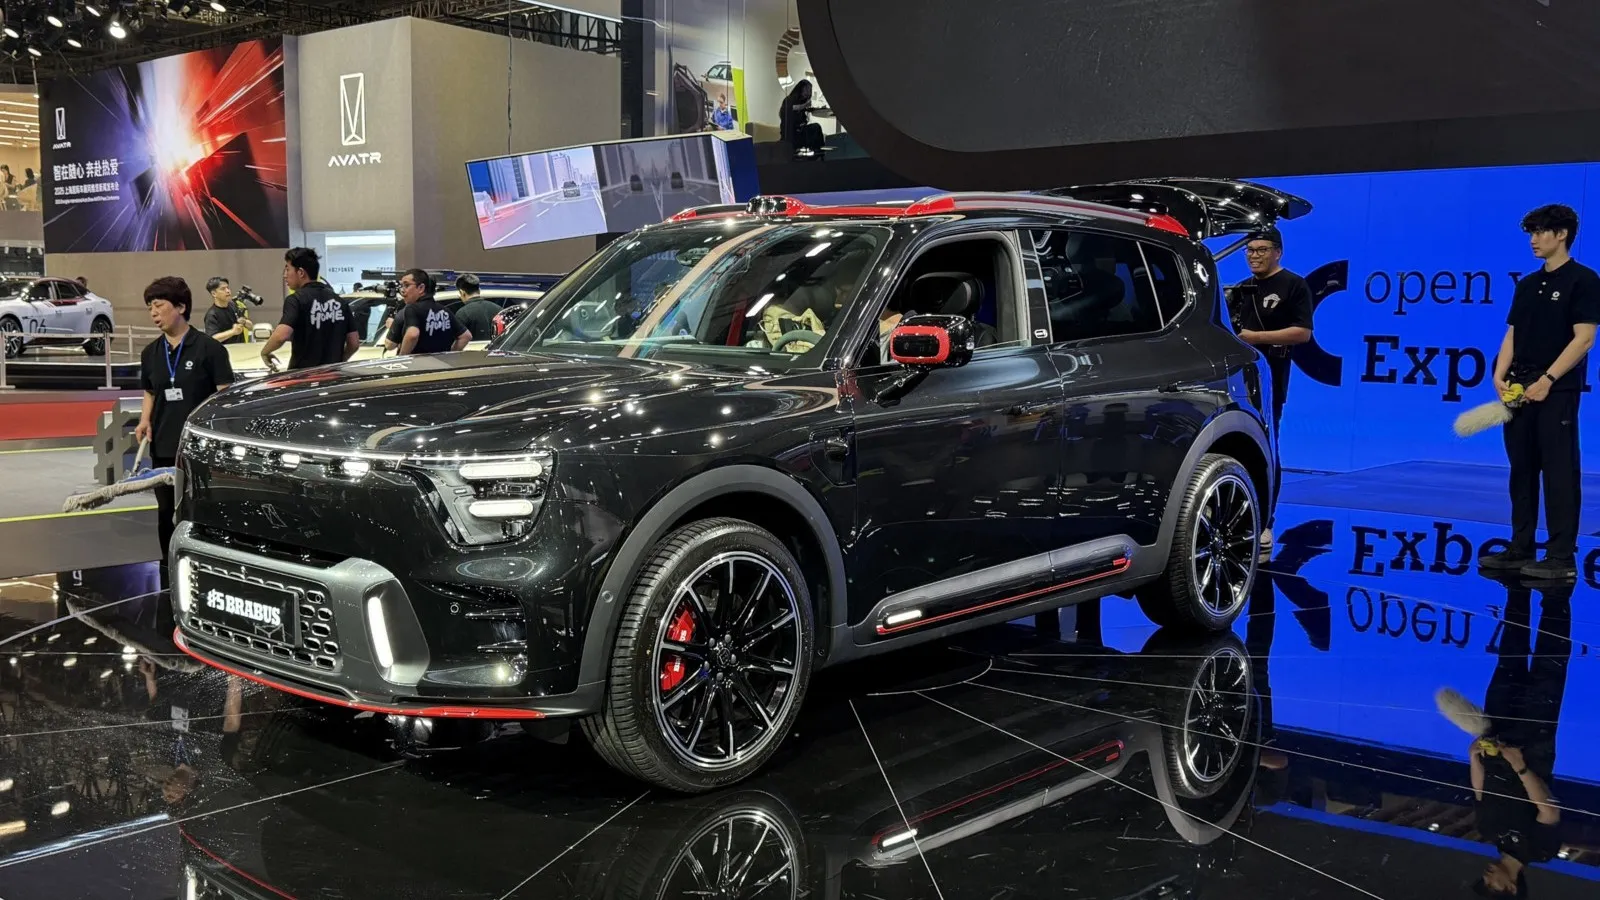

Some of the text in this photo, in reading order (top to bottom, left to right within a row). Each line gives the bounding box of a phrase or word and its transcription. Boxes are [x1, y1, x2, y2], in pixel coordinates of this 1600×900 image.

[53, 142, 72, 150] AVATR
[86, 159, 119, 178] 奔赴热爱
[328, 152, 382, 167] AVATR
[1365, 271, 1493, 316] open
[310, 311, 345, 330] HOME
[425, 319, 451, 336] HOME
[1361, 334, 1498, 402] Exp
[206, 588, 281, 626] #5 BRABUS
